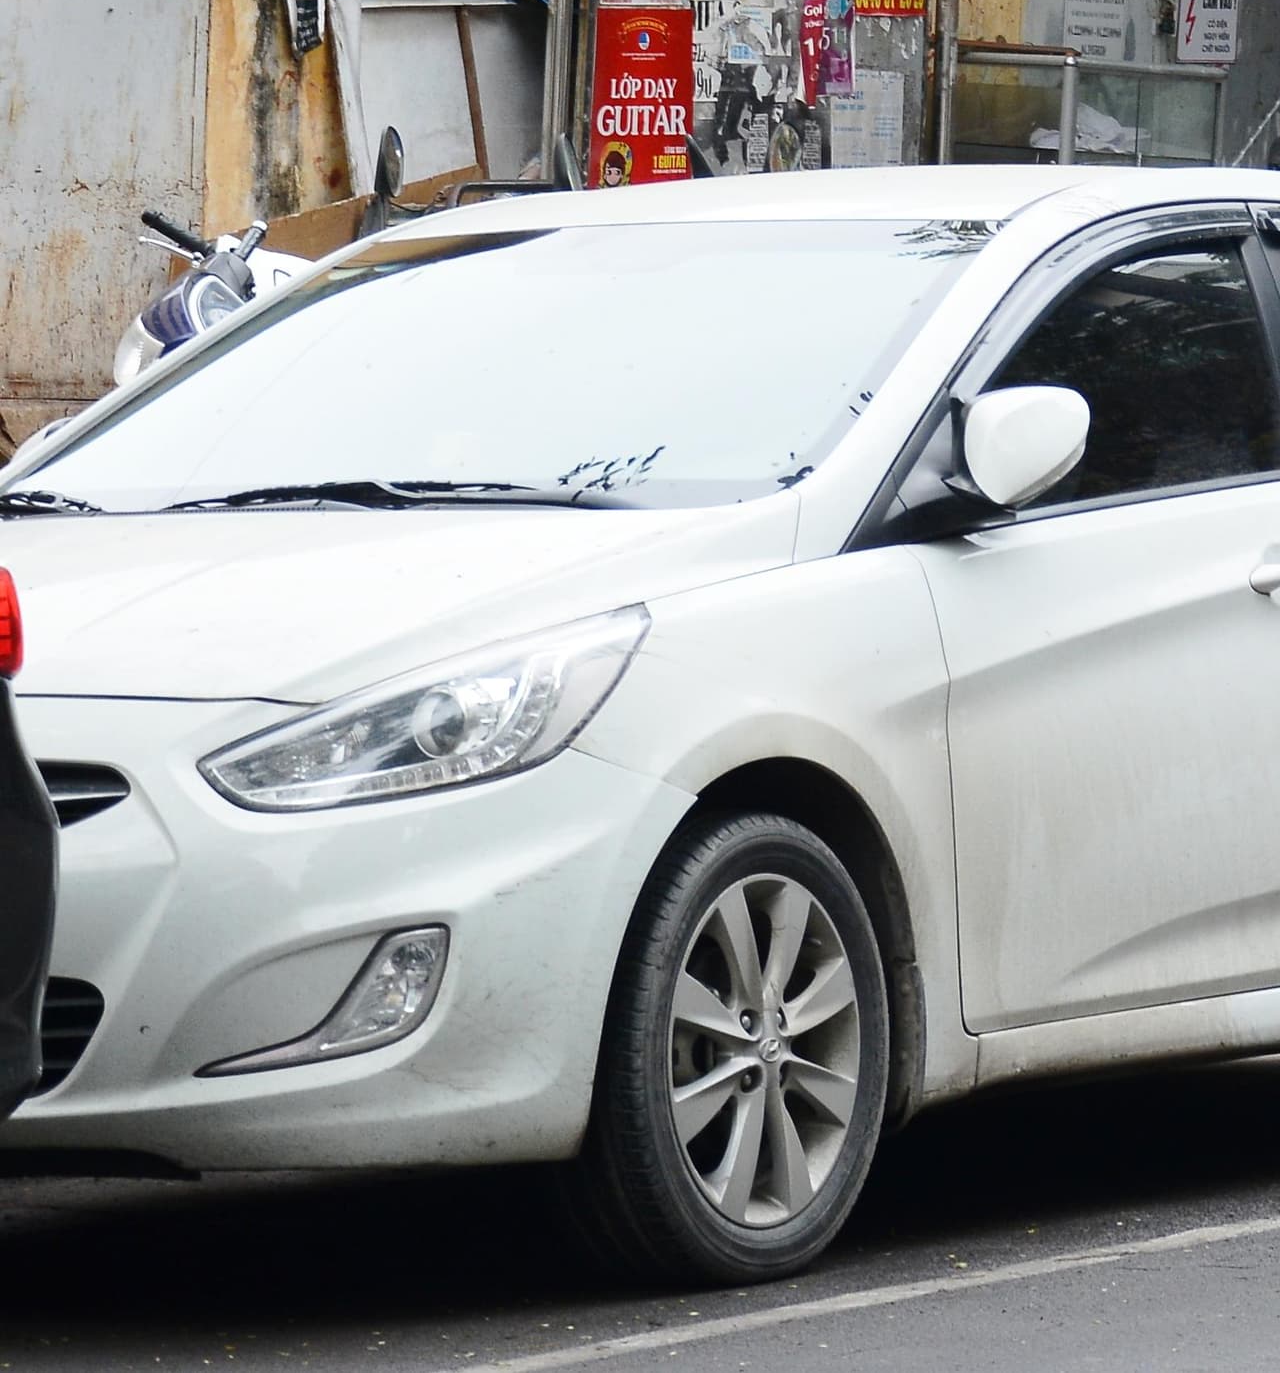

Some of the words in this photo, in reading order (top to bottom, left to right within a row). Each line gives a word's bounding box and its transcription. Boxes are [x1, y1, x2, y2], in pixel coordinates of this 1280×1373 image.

[610, 73, 642, 99] LỚP
[643, 78, 678, 103] DẠY
[597, 105, 688, 137] GUITAR
[659, 154, 688, 170] GUITAR
